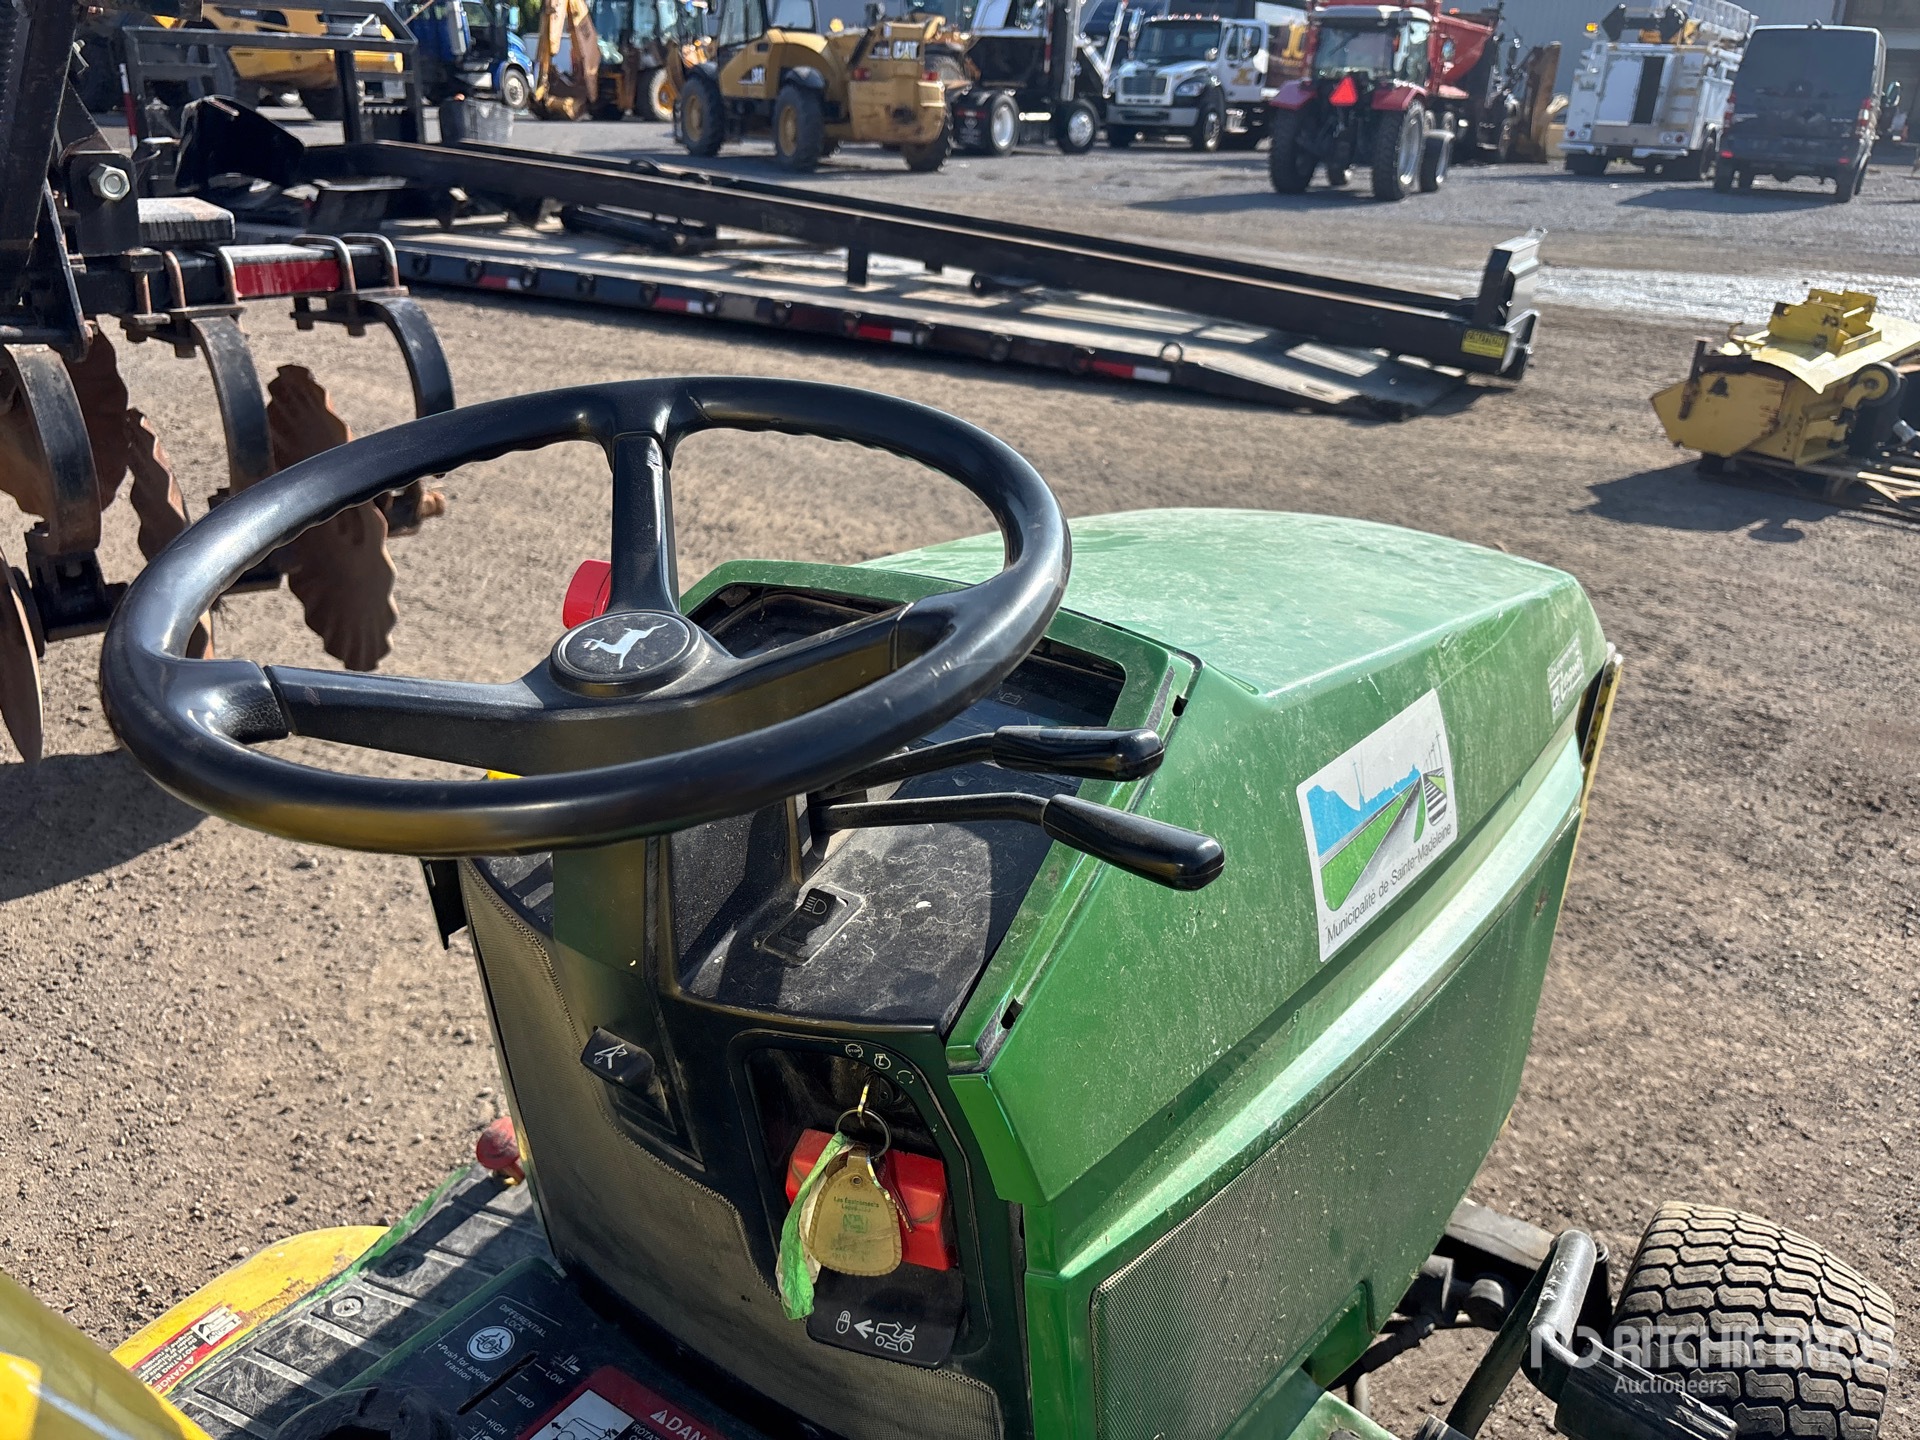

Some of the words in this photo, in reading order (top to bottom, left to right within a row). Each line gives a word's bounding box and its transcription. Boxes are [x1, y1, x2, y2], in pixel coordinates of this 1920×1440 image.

[892, 40, 919, 60] CAT
[1327, 889, 1376, 943] Municipalité
[1378, 881, 1389, 898] de
[1391, 824, 1452, 886] Sainte-Madeleine
[499, 1304, 546, 1337] DIFFERENTIAL
[504, 1317, 526, 1333] LOCK
[145, 1372, 162, 1386] BLA
[154, 1364, 187, 1392] DANGE
[445, 1359, 472, 1381] traction
[459, 1356, 469, 1368] for
[468, 1365, 491, 1382] added
[545, 1370, 565, 1385] LOW
[516, 1394, 535, 1409] MED
[486, 1419, 508, 1435] HIGH
[666, 1416, 706, 1440] DAN
